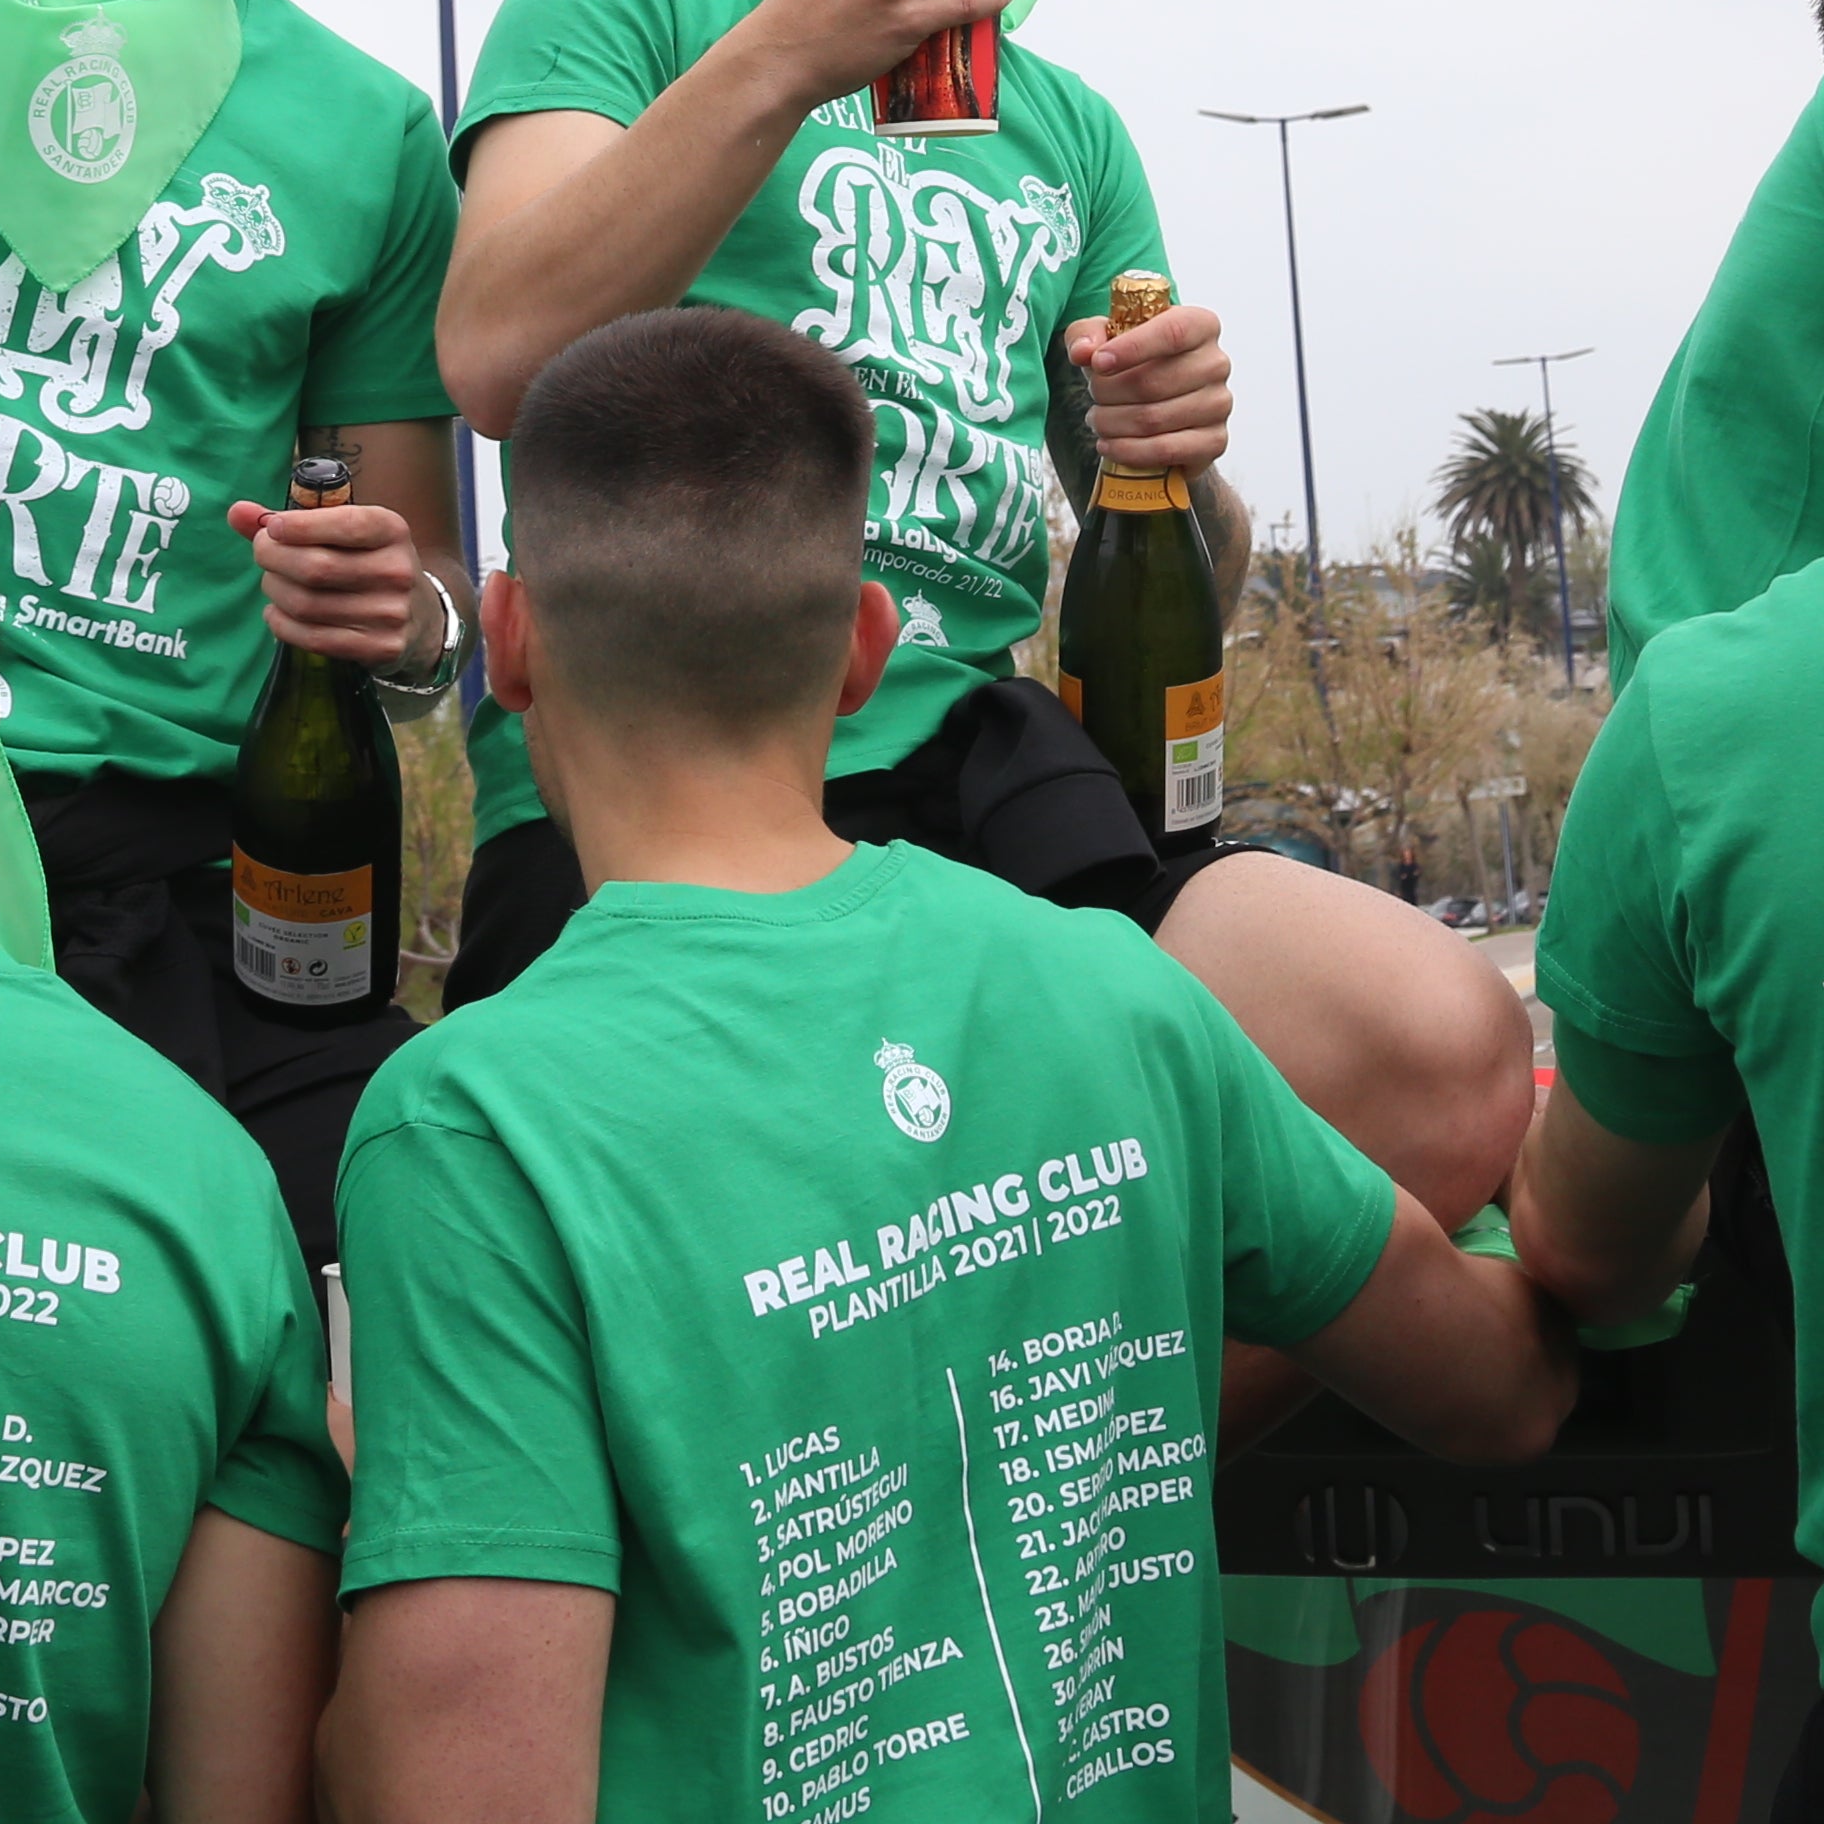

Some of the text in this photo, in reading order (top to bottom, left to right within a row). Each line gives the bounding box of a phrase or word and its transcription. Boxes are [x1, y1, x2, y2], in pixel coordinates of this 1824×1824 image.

[33, 77, 64, 119] REAL
[41, 143, 125, 179] SANTANDER
[864, 548, 952, 584] mporada
[17, 596, 187, 660] SmartBank
[264, 880, 345, 905] Arlene
[320, 906, 353, 918] CAVA
[743, 1137, 1148, 1318] REAL RACING CLUB
[808, 1195, 1122, 1340] PLANTILLA 2021 2022
[2, 1414, 34, 1444] D.
[740, 1426, 841, 1488] 1. LUCAS
[1108, 1549, 1195, 1590] JUSTO
[1082, 1702, 1171, 1757] CASTRO
[762, 1712, 970, 1821] 10. PABLO TORRE
[1066, 1738, 1176, 1802] CEBALLOS
